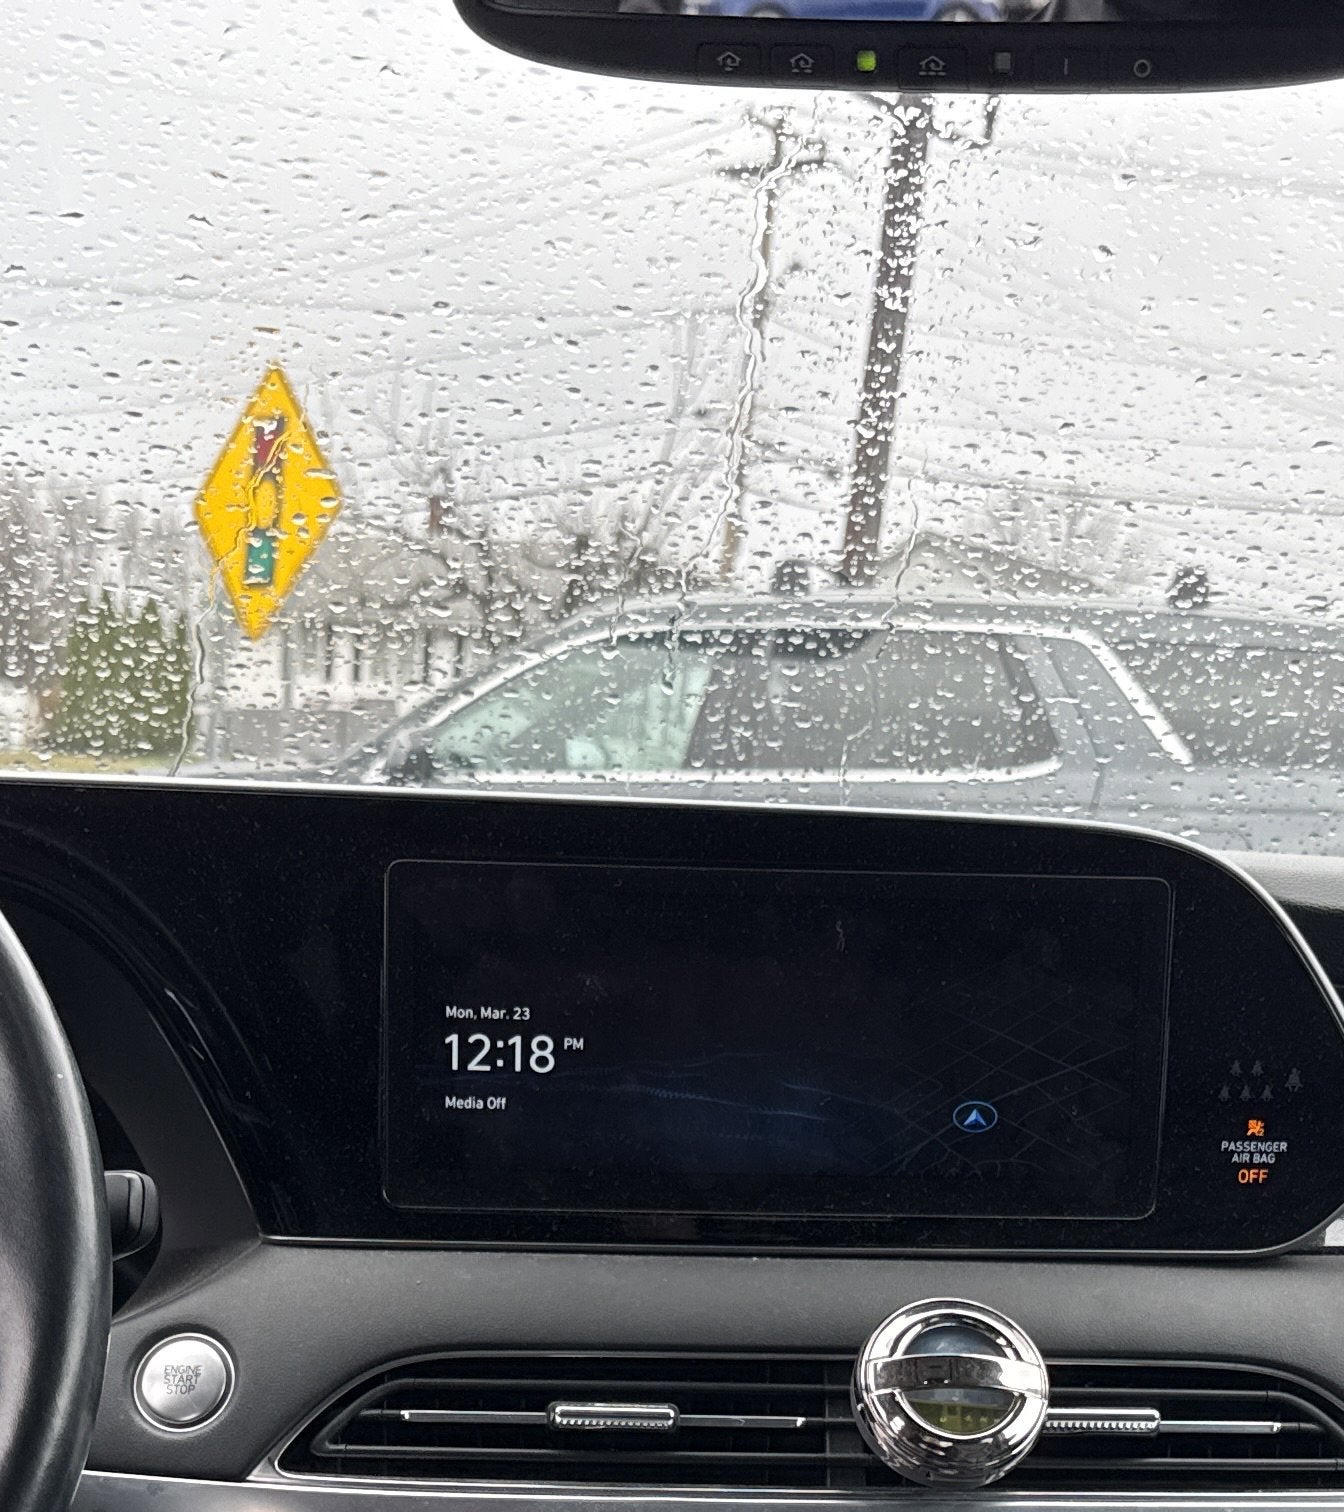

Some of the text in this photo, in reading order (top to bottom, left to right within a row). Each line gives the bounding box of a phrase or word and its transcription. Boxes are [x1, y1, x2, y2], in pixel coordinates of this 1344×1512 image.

[445, 1005, 531, 1021] Mon, Mar. 23
[444, 1033, 584, 1073] 12:18 PM
[444, 1096, 506, 1110] Media Off
[1220, 1140, 1288, 1152] PASSENGER
[1231, 1152, 1276, 1164] AIR BAG
[1237, 1168, 1269, 1184] OFF
[163, 1364, 203, 1375] ENGINE
[163, 1373, 202, 1385] START
[166, 1384, 196, 1395] STOP
